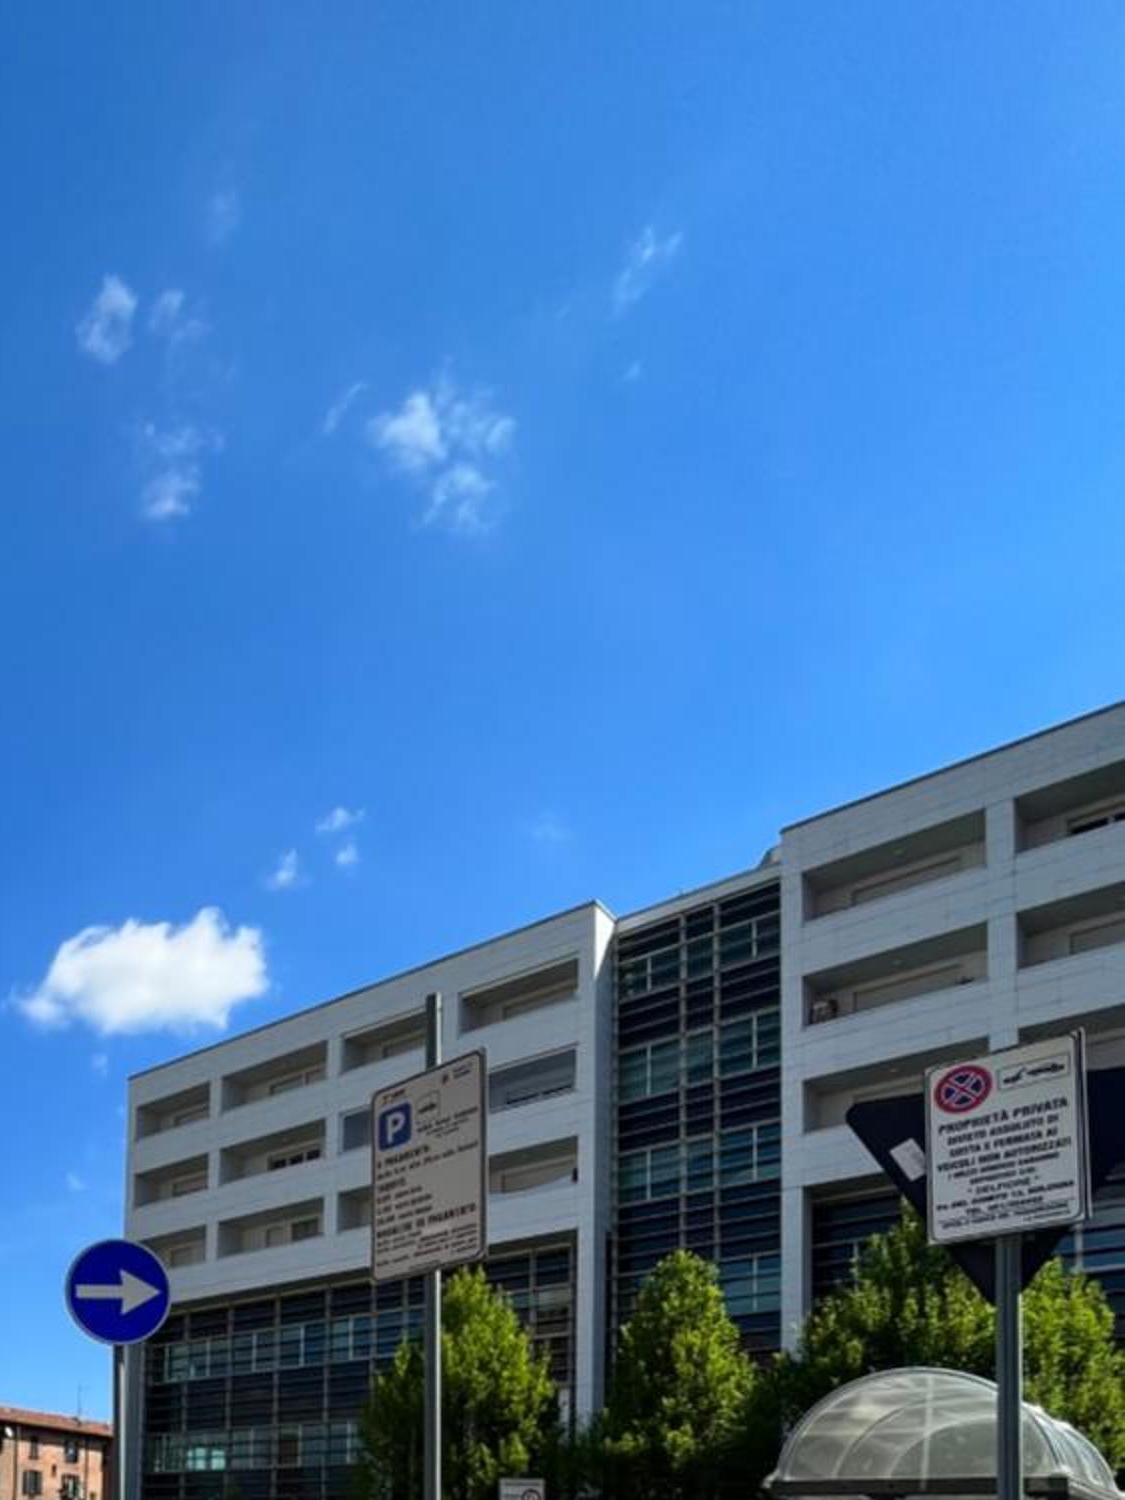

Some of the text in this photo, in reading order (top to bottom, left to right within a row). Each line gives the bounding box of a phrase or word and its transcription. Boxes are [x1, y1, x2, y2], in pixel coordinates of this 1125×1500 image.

[1012, 1097, 1068, 1118] PRIVATA
[386, 1111, 406, 1143] P
[993, 1131, 1043, 1149] FERMATA
[937, 1157, 976, 1172] VEICOLI
[1004, 1137, 1072, 1159] AUTORIZZATI
